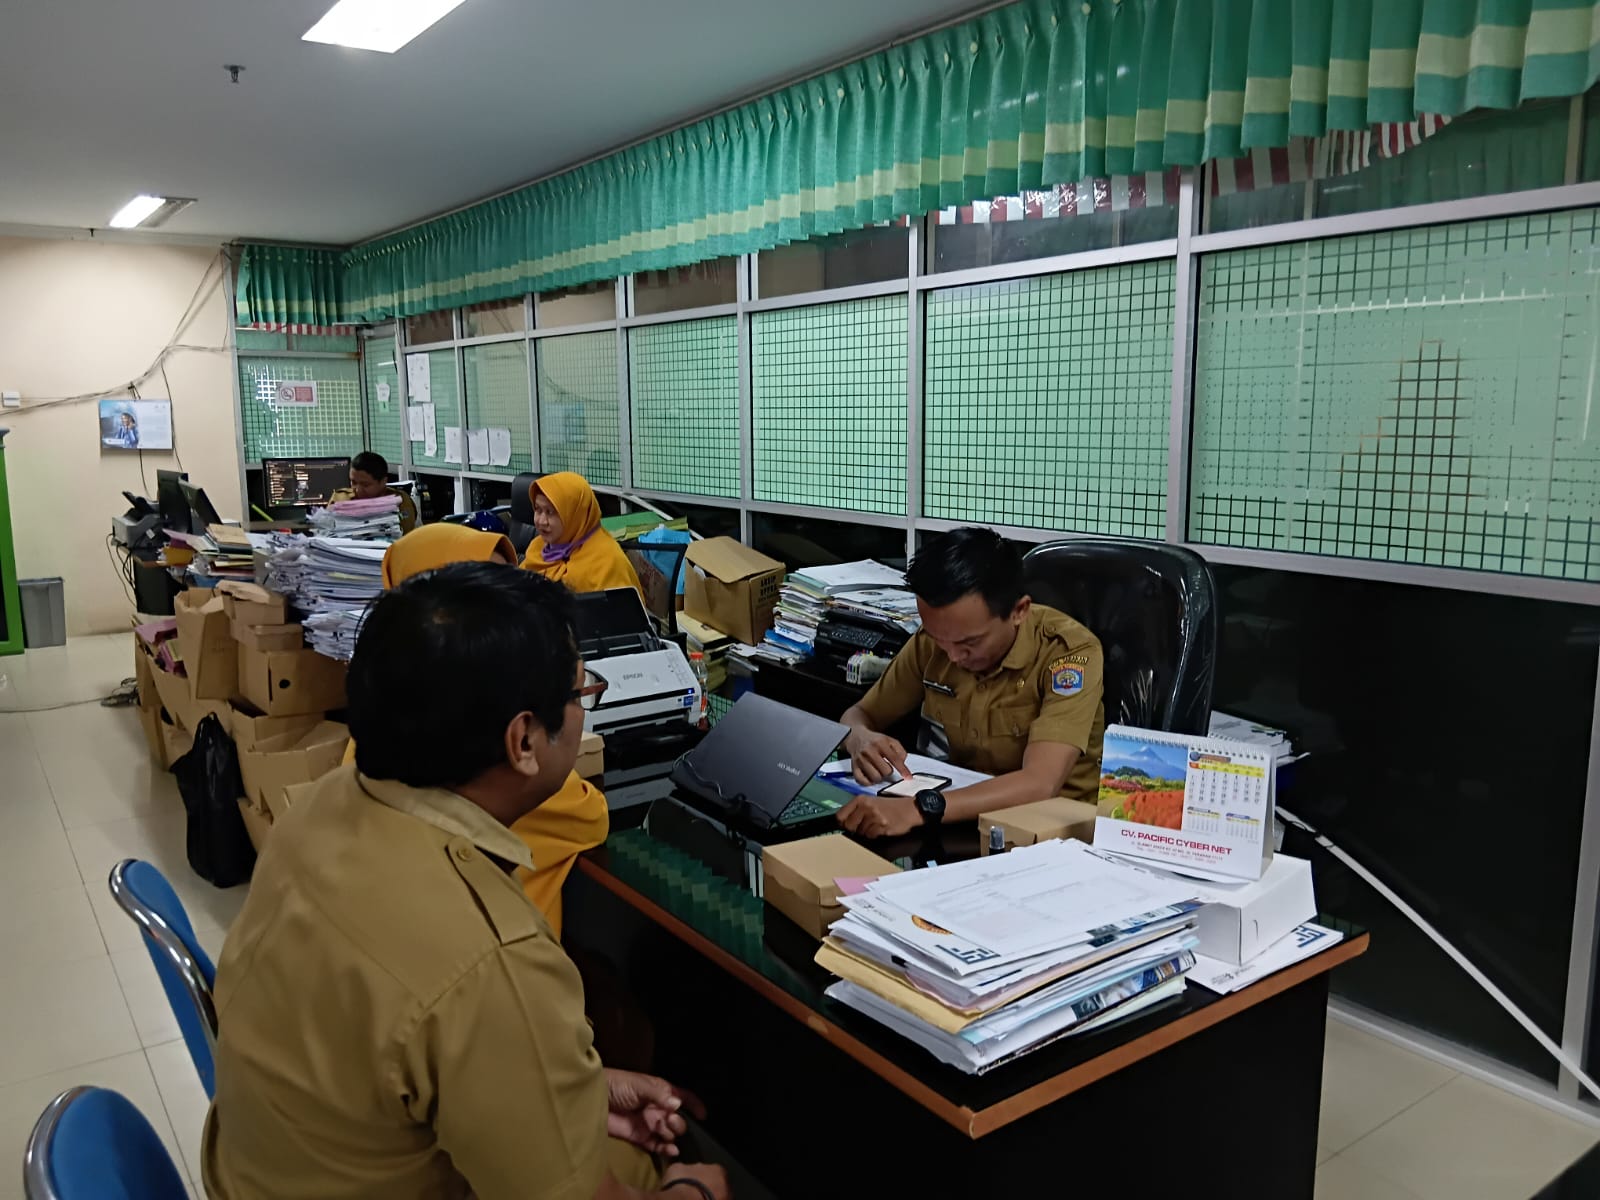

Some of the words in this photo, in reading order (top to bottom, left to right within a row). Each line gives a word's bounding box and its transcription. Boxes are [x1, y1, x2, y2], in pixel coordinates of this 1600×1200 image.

[1121, 829, 1137, 839] CV.
[1138, 832, 1175, 846] PACIFIC
[1176, 839, 1210, 852] CYBER
[1211, 845, 1233, 856] NET
